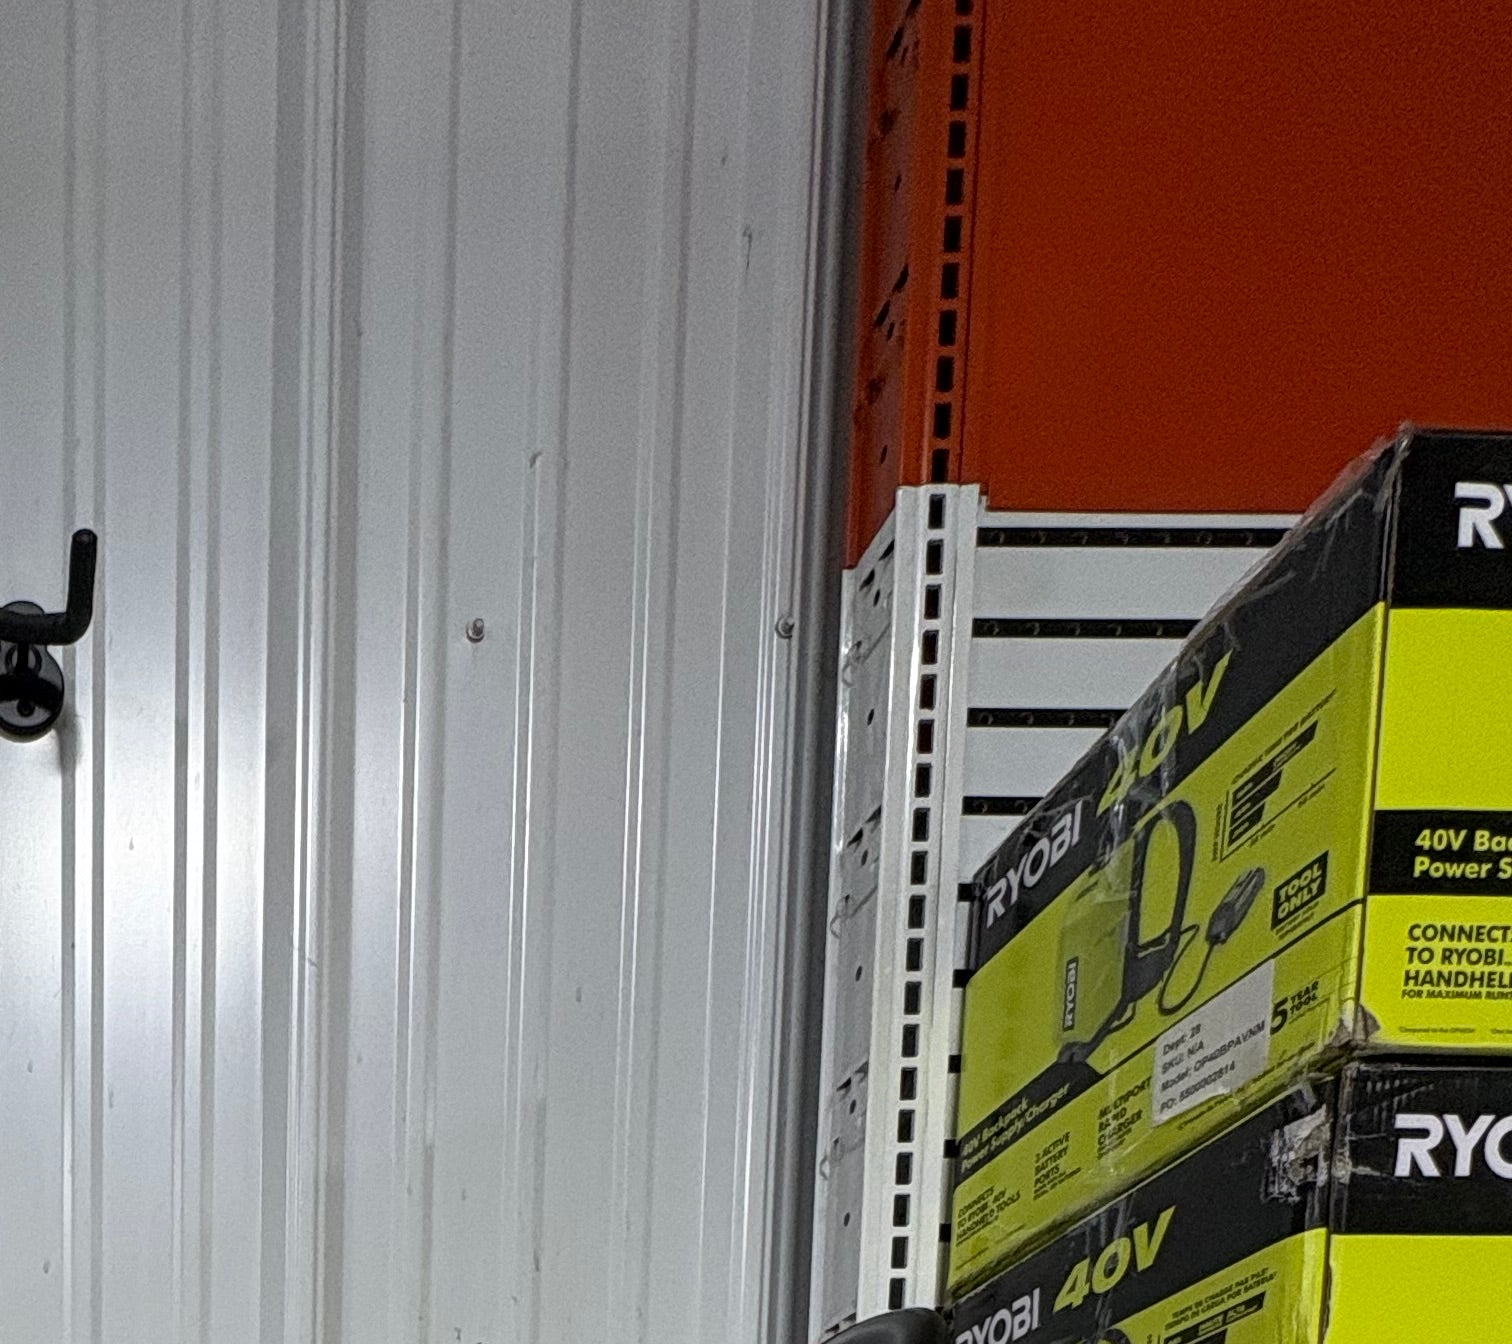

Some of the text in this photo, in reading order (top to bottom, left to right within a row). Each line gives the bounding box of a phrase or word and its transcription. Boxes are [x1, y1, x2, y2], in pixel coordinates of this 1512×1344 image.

[1455, 482, 1512, 549] R
[986, 648, 1233, 928] RYOBI 40V
[1415, 829, 1467, 851] 40V
[1413, 856, 1492, 878] Power
[1279, 862, 1322, 903] TOOL
[1278, 877, 1321, 919] ONLY
[1408, 924, 1512, 943] CONNECT
[1405, 947, 1434, 964] TO
[1291, 981, 1319, 1003] YEAR
[1403, 970, 1512, 988] HANDHEL
[1271, 997, 1288, 1035] 5
[1053, 1205, 1176, 1315] 40V
